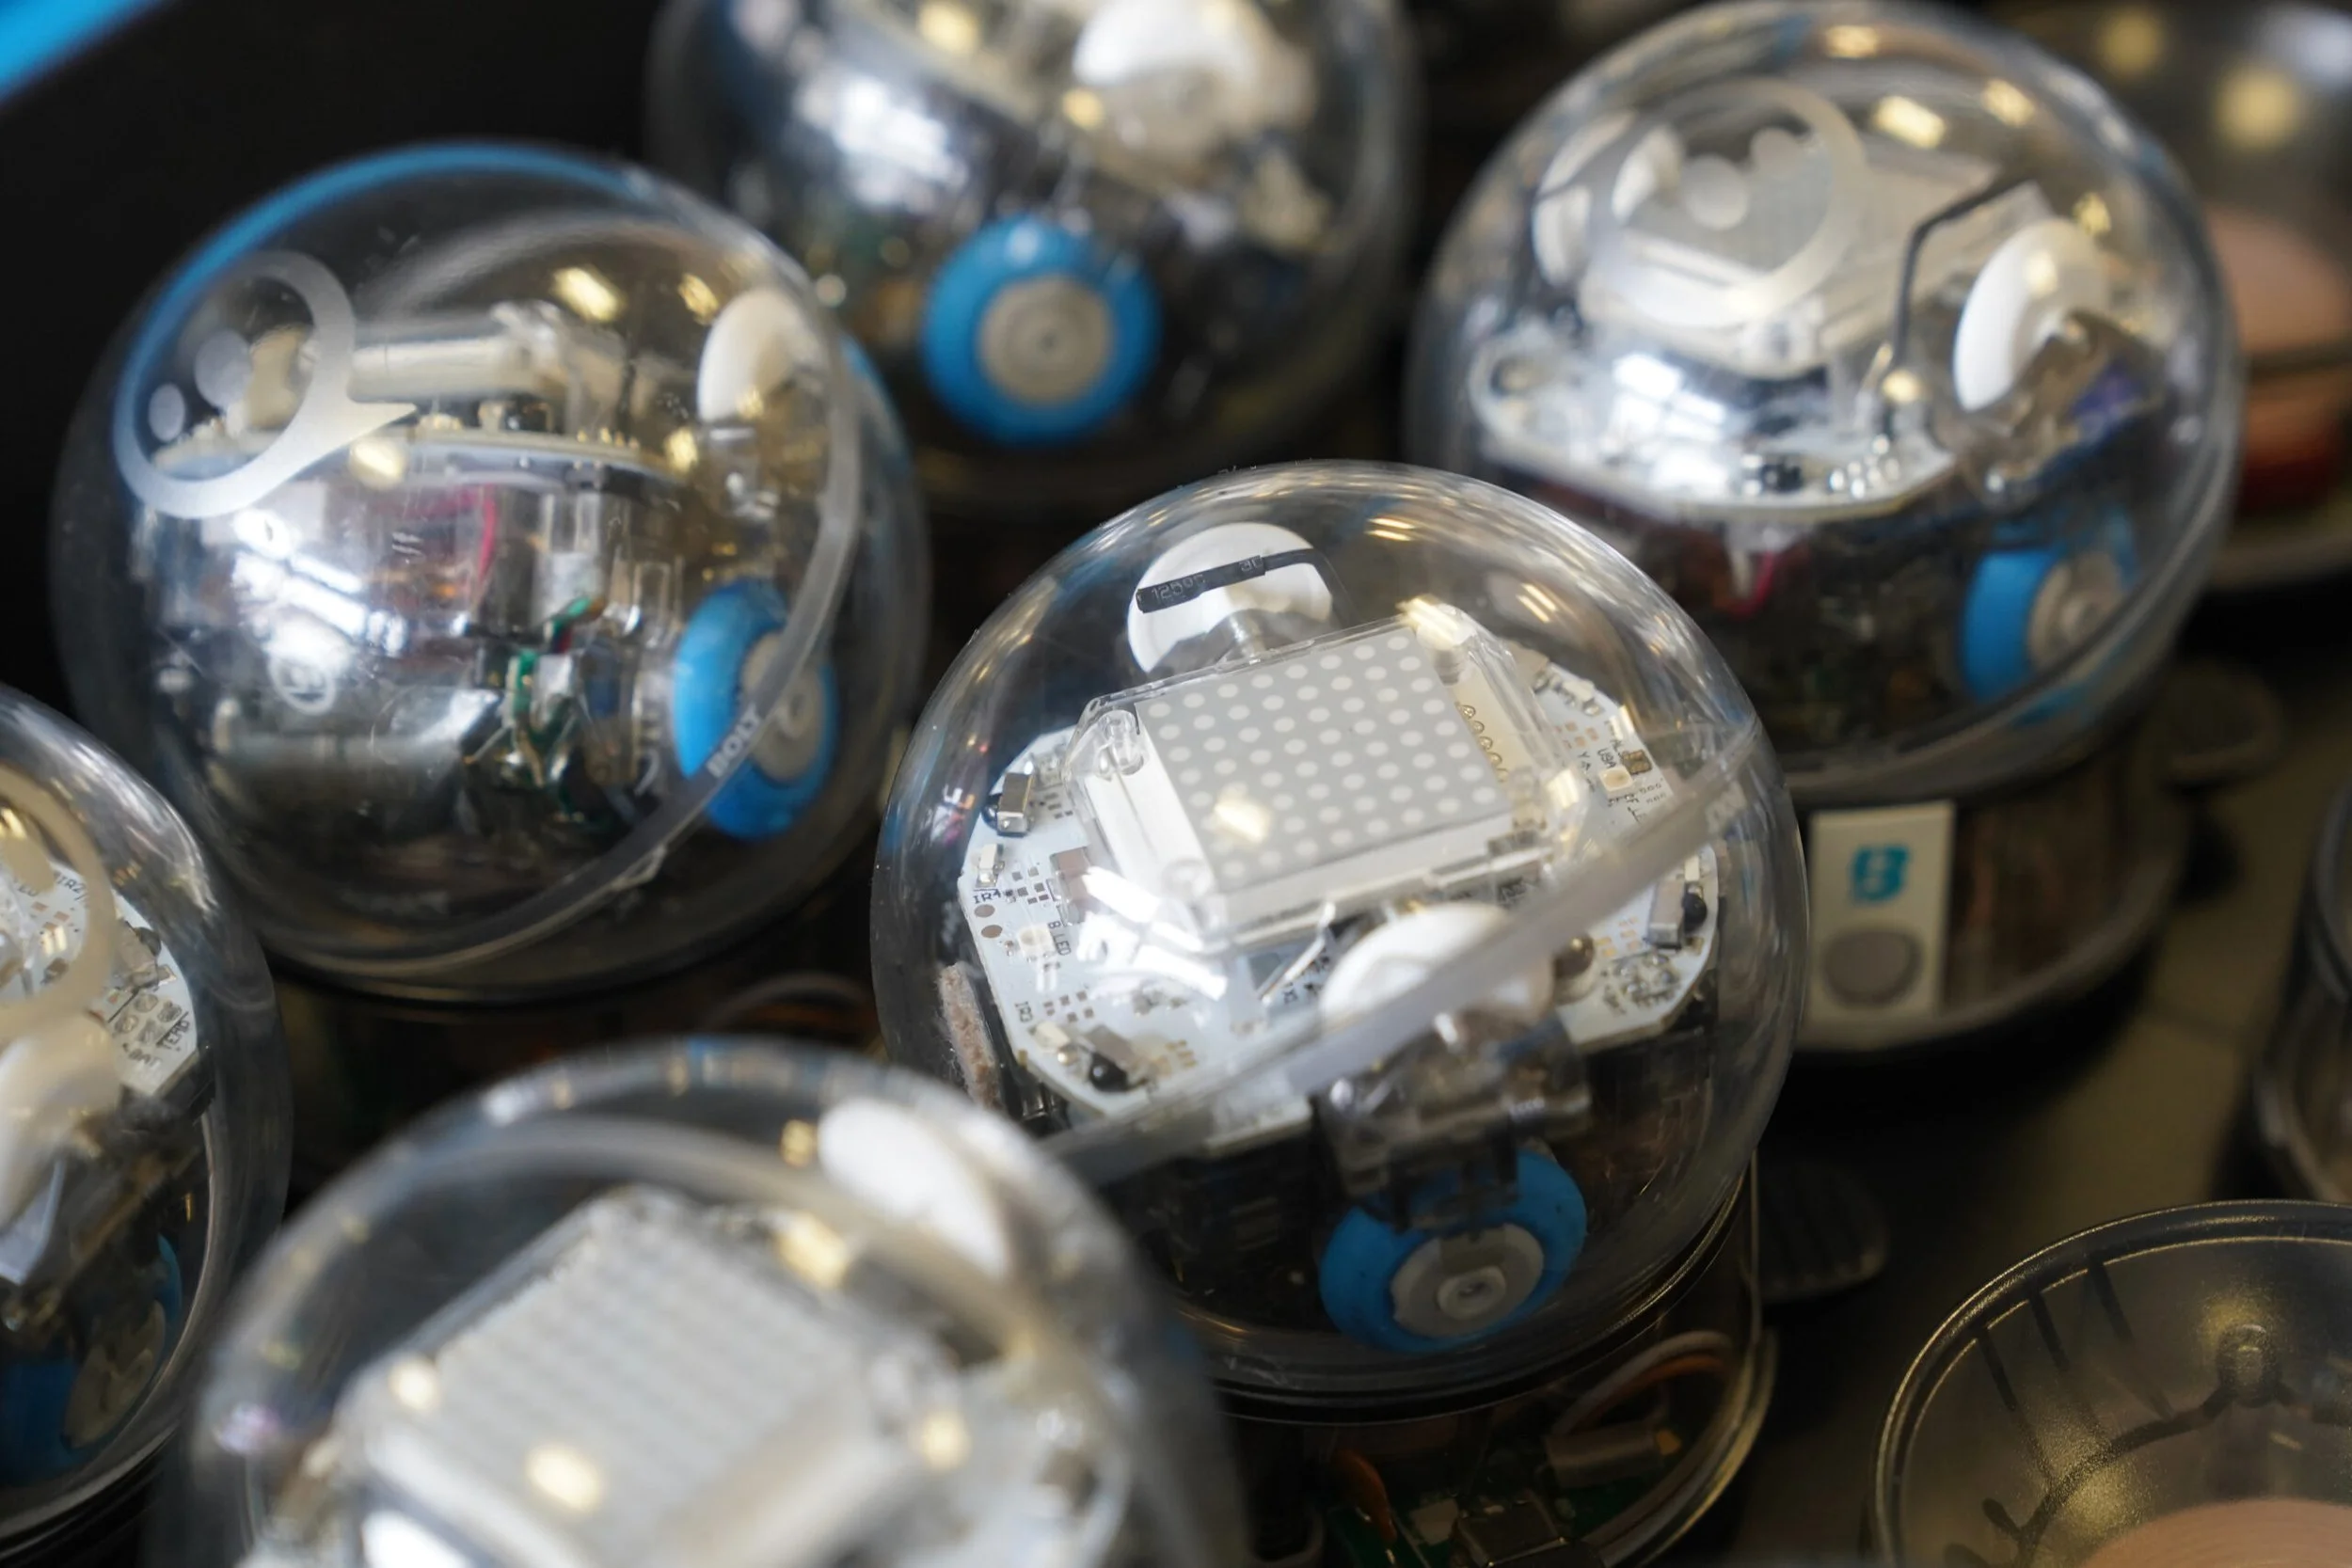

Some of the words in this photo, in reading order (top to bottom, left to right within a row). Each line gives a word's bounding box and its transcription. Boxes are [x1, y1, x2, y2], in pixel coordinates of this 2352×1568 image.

[707, 702, 761, 778] BOLT
[974, 889, 1001, 904] IR4
[1052, 933, 1072, 956] LED
